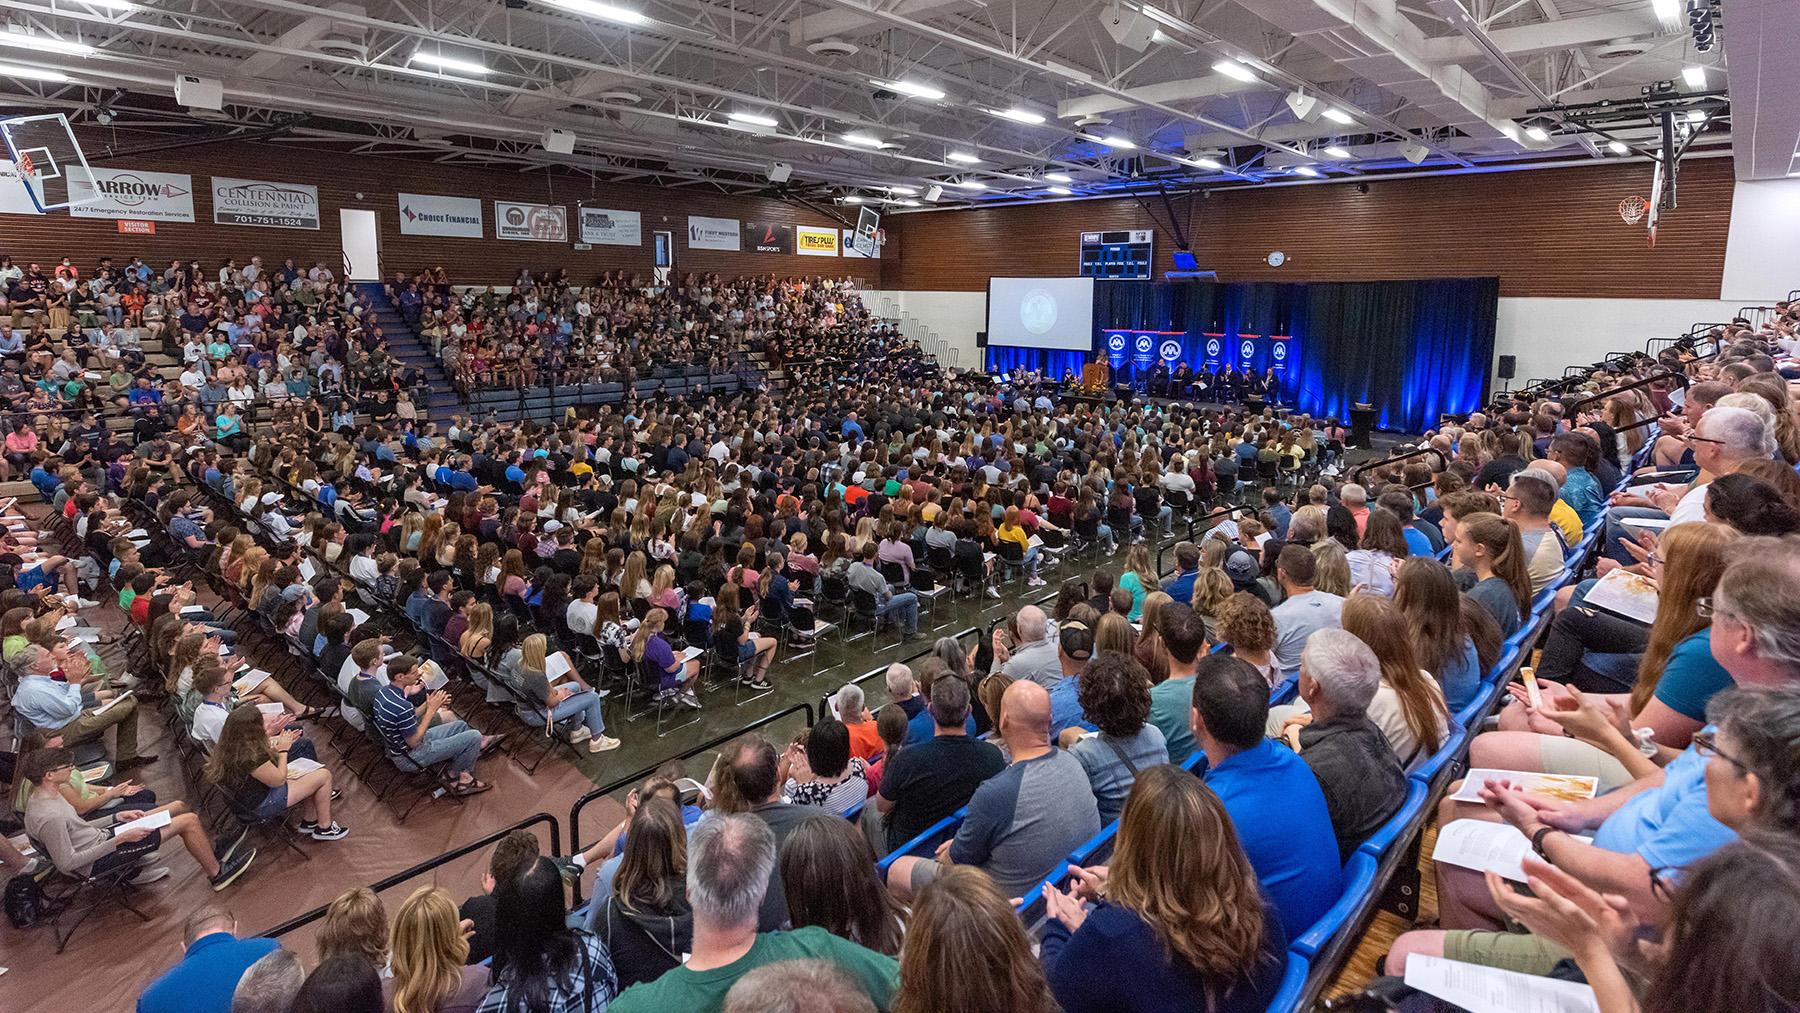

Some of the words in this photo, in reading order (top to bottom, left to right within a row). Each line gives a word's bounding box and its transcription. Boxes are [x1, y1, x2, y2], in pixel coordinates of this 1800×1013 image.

[96, 180, 161, 196] ARROW
[217, 187, 310, 204] CENTENNIAL
[224, 198, 271, 208] COLLISION
[90, 207, 127, 215] Emergency
[234, 215, 302, 226] 701-751-1524
[418, 212, 444, 222] CHOICE
[446, 214, 480, 224] FINANCIAL
[820, 236, 834, 244] PLUS
